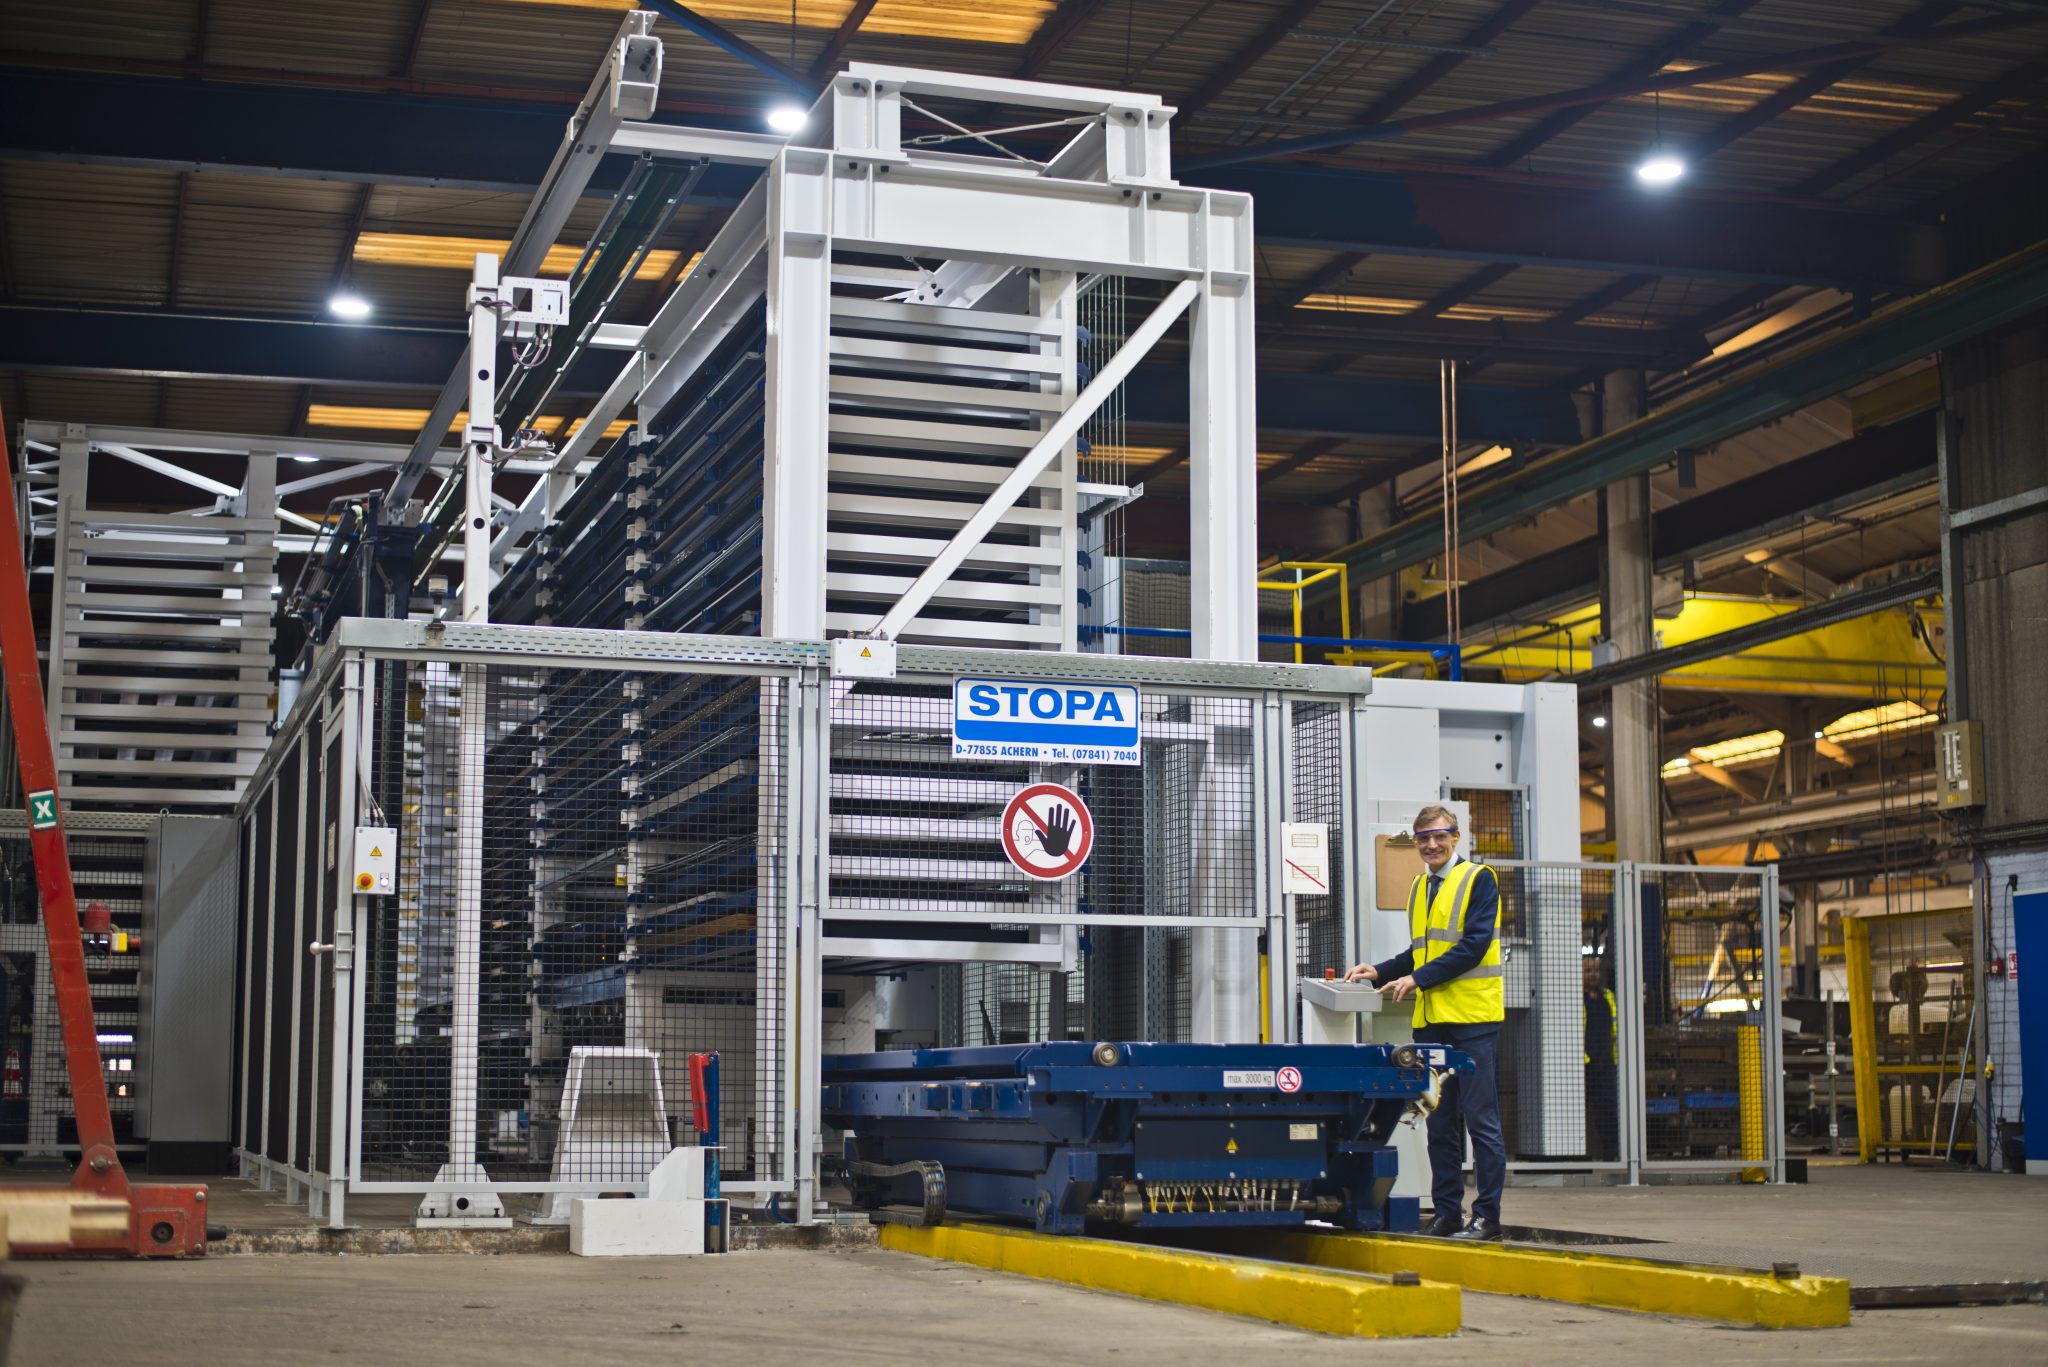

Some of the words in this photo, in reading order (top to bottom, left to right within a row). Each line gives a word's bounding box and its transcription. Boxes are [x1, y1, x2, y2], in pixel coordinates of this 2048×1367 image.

[968, 684, 1124, 722] STOPA
[955, 744, 998, 756] D-77855
[1000, 745, 1039, 757] ACHERN
[1052, 747, 1069, 759] Tel.
[1072, 748, 1110, 762] (07841)
[1113, 750, 1137, 761] 7040
[1245, 1073, 1262, 1084] 3000
[1263, 1073, 1272, 1086] kg
